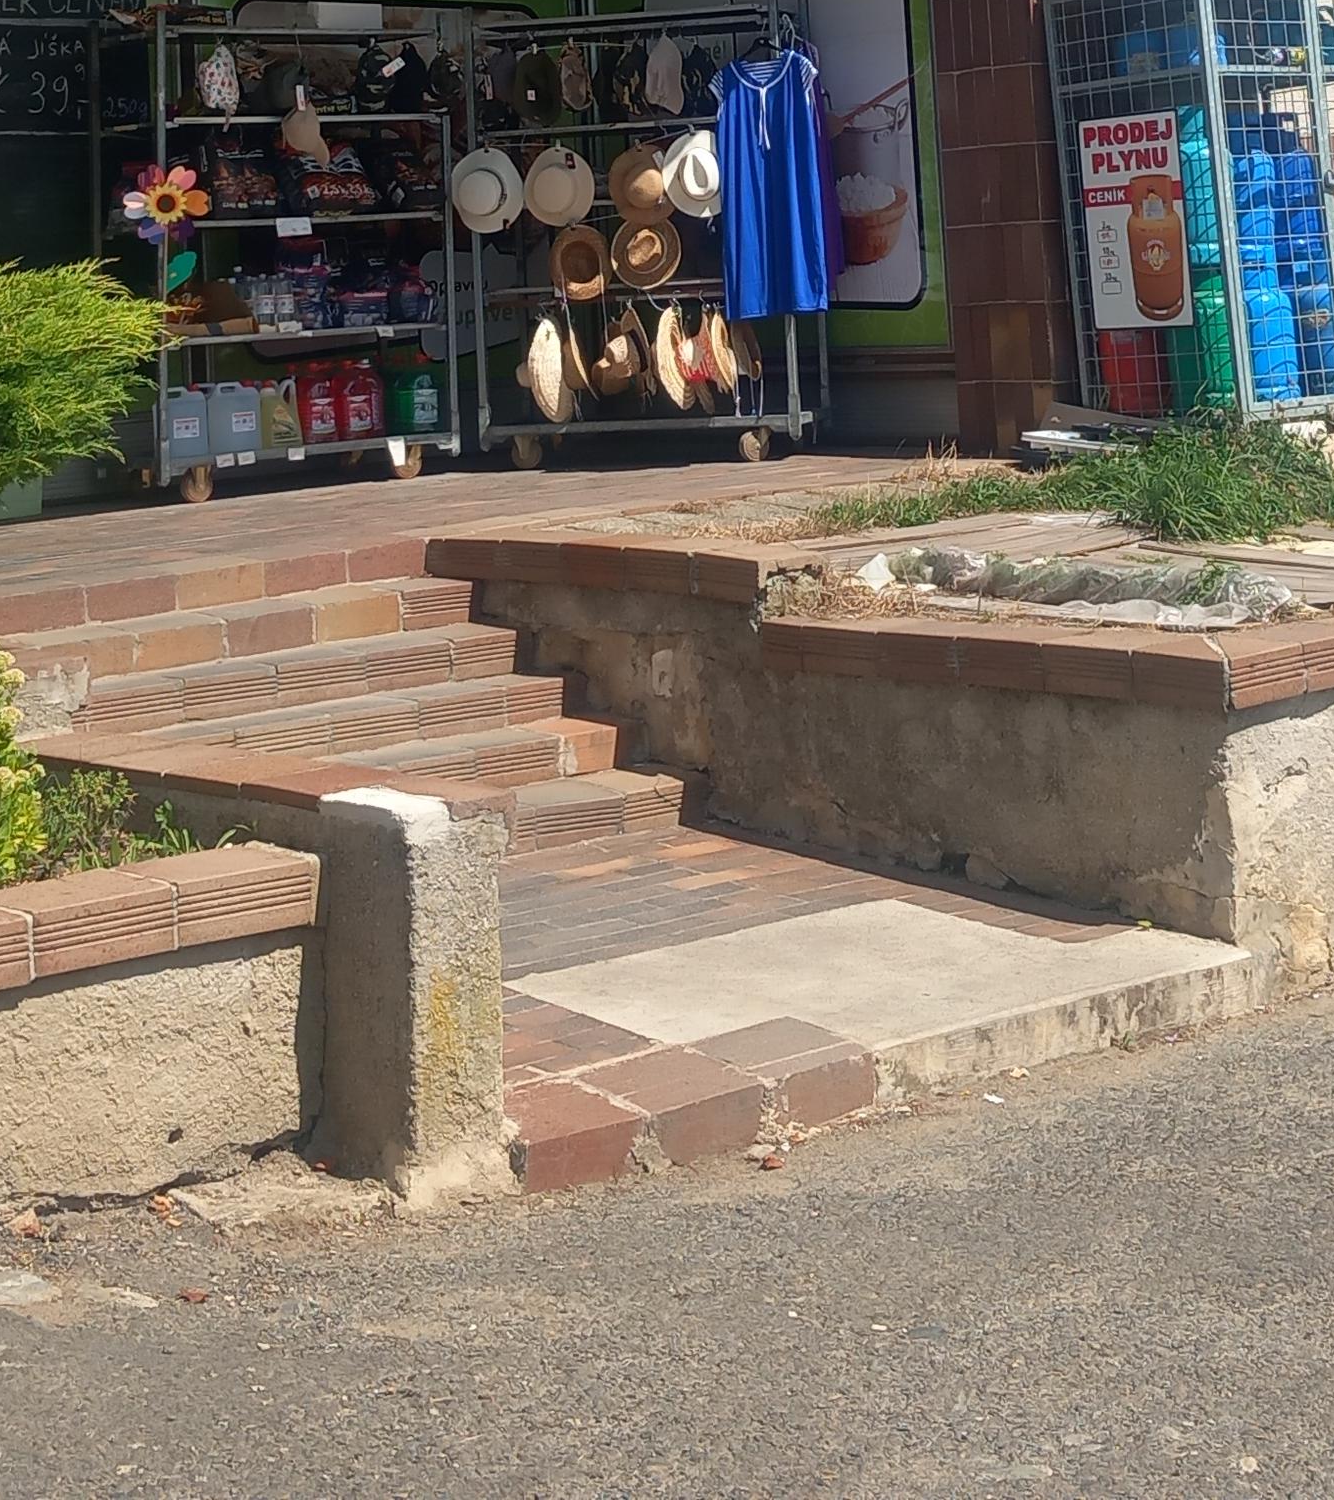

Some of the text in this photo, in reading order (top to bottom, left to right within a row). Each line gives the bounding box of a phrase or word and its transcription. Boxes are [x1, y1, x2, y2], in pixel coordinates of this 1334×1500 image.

[27, 32, 86, 60] JÍŠKA
[1083, 118, 1173, 148] PRODEJ
[1091, 147, 1169, 174] PLYNU
